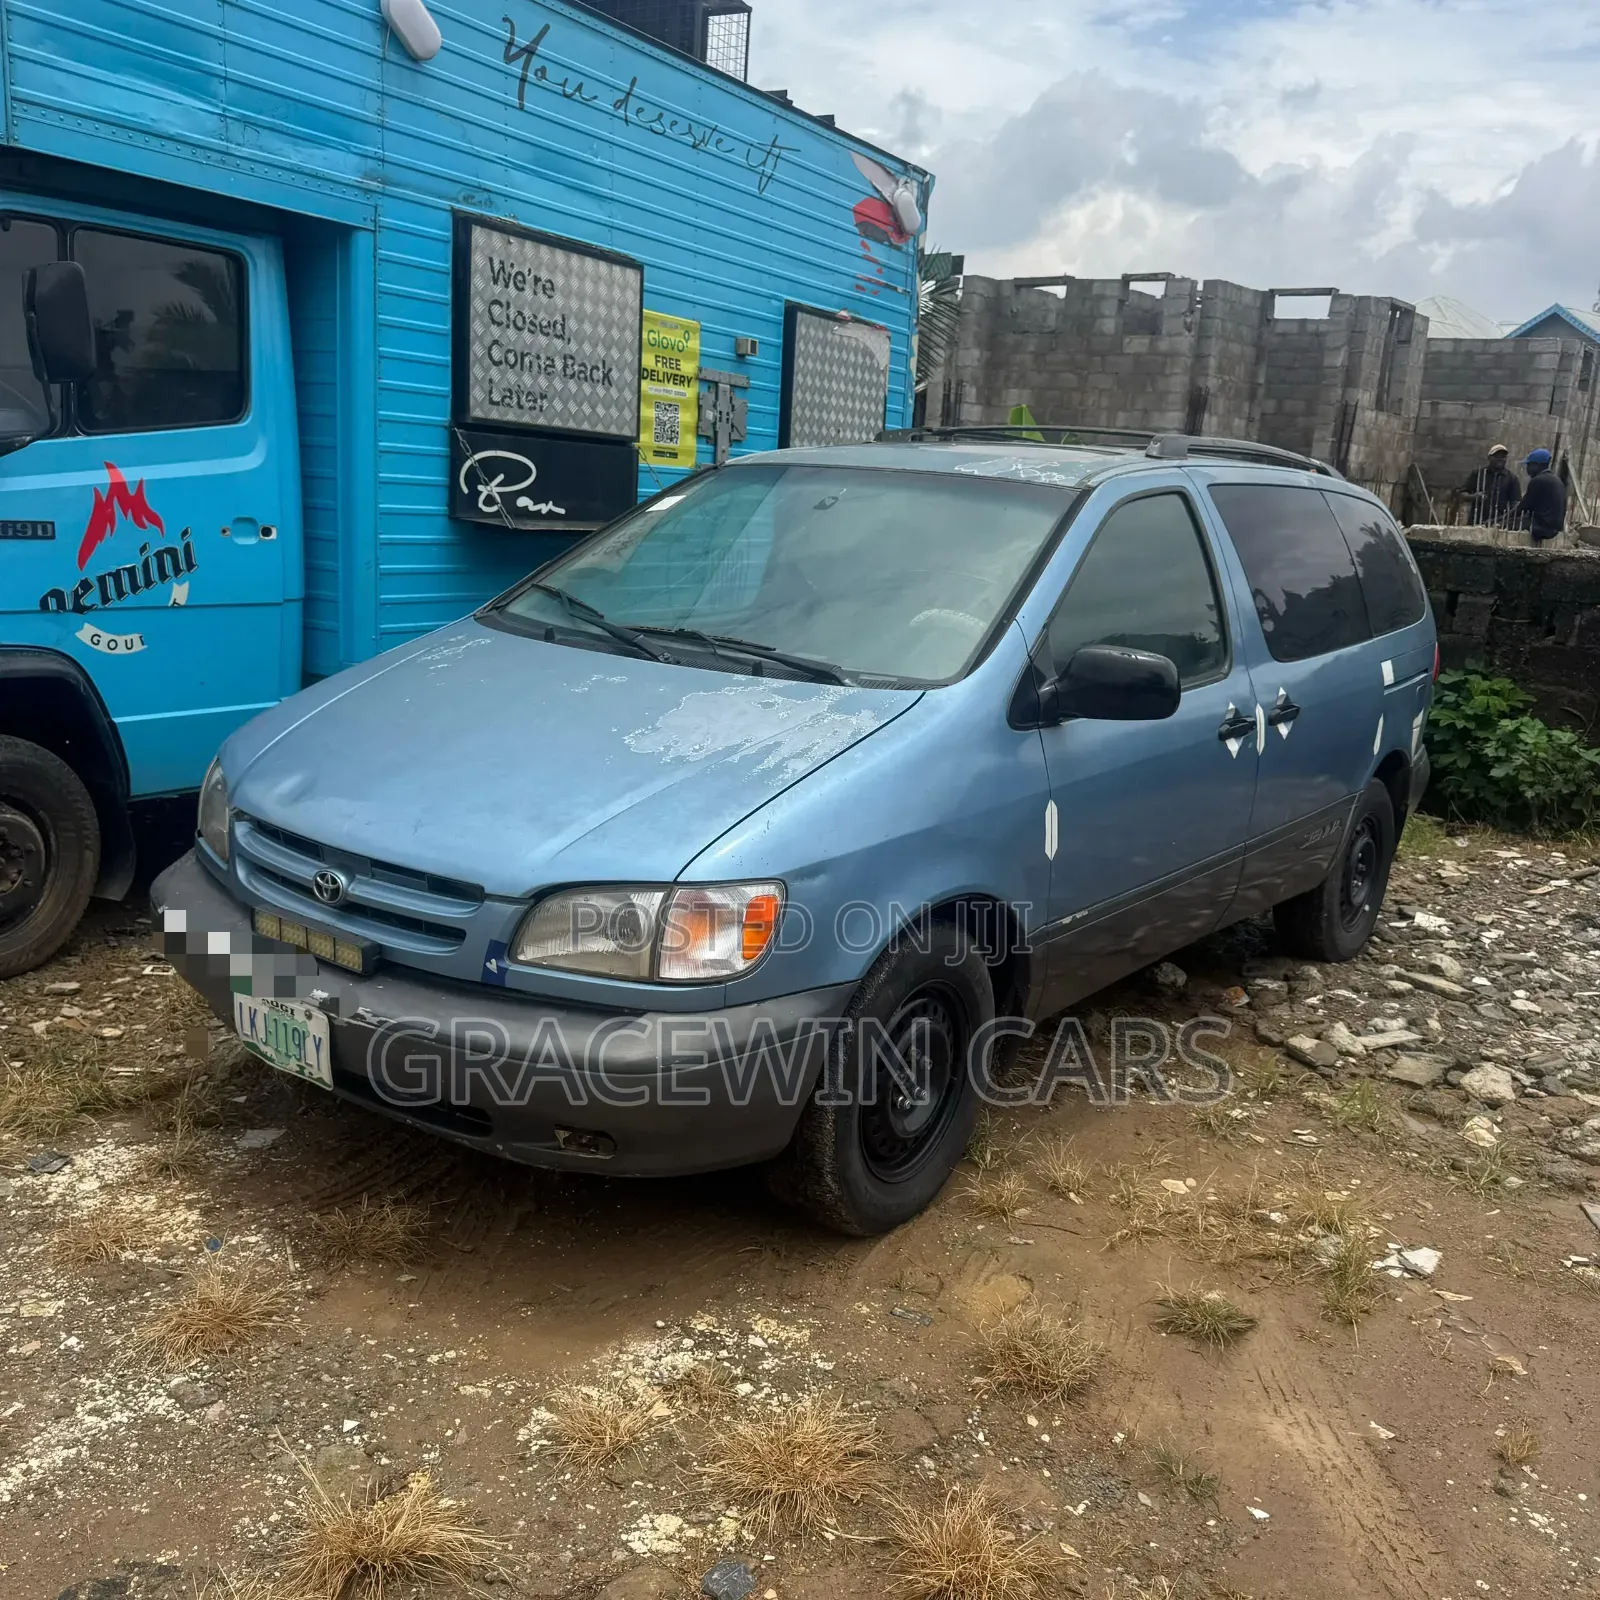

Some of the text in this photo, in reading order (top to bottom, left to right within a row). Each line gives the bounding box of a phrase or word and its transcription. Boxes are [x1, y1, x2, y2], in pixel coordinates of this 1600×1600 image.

[502, 16, 801, 195] You deserve it
[488, 256, 556, 300] We're
[487, 299, 572, 346] Closed,
[647, 329, 685, 353] Glovo
[487, 339, 614, 388] Come Back
[642, 367, 693, 388] DELIVERY
[655, 354, 682, 371] FREE
[488, 378, 549, 413] Later
